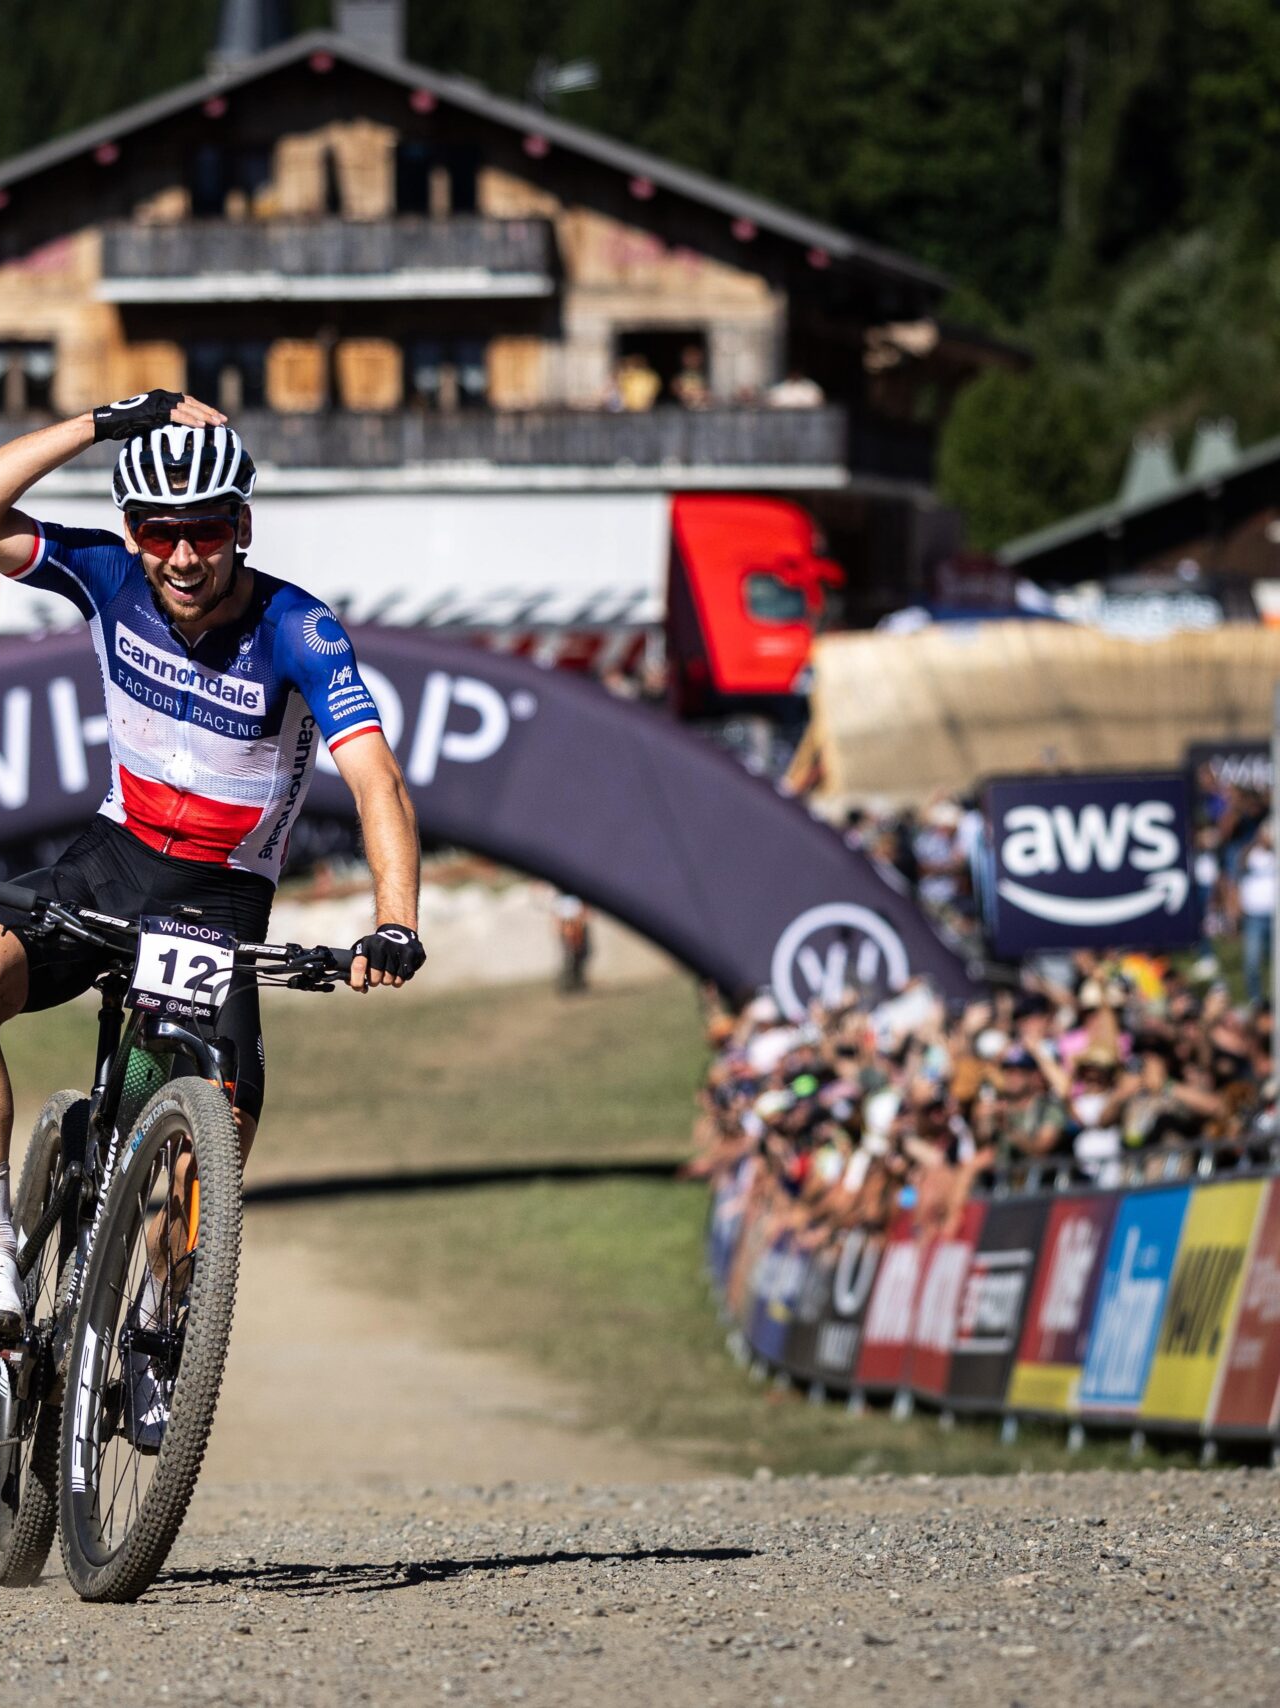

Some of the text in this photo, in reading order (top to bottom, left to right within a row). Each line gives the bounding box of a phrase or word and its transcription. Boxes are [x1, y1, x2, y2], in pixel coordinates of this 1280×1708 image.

[118, 669, 262, 737] FACTORY RACING
[119, 636, 261, 709] cannondale
[258, 715, 316, 860] cannondale
[1002, 801, 1180, 876] aws
[159, 921, 220, 941] WHOOP
[158, 948, 218, 994] 12
